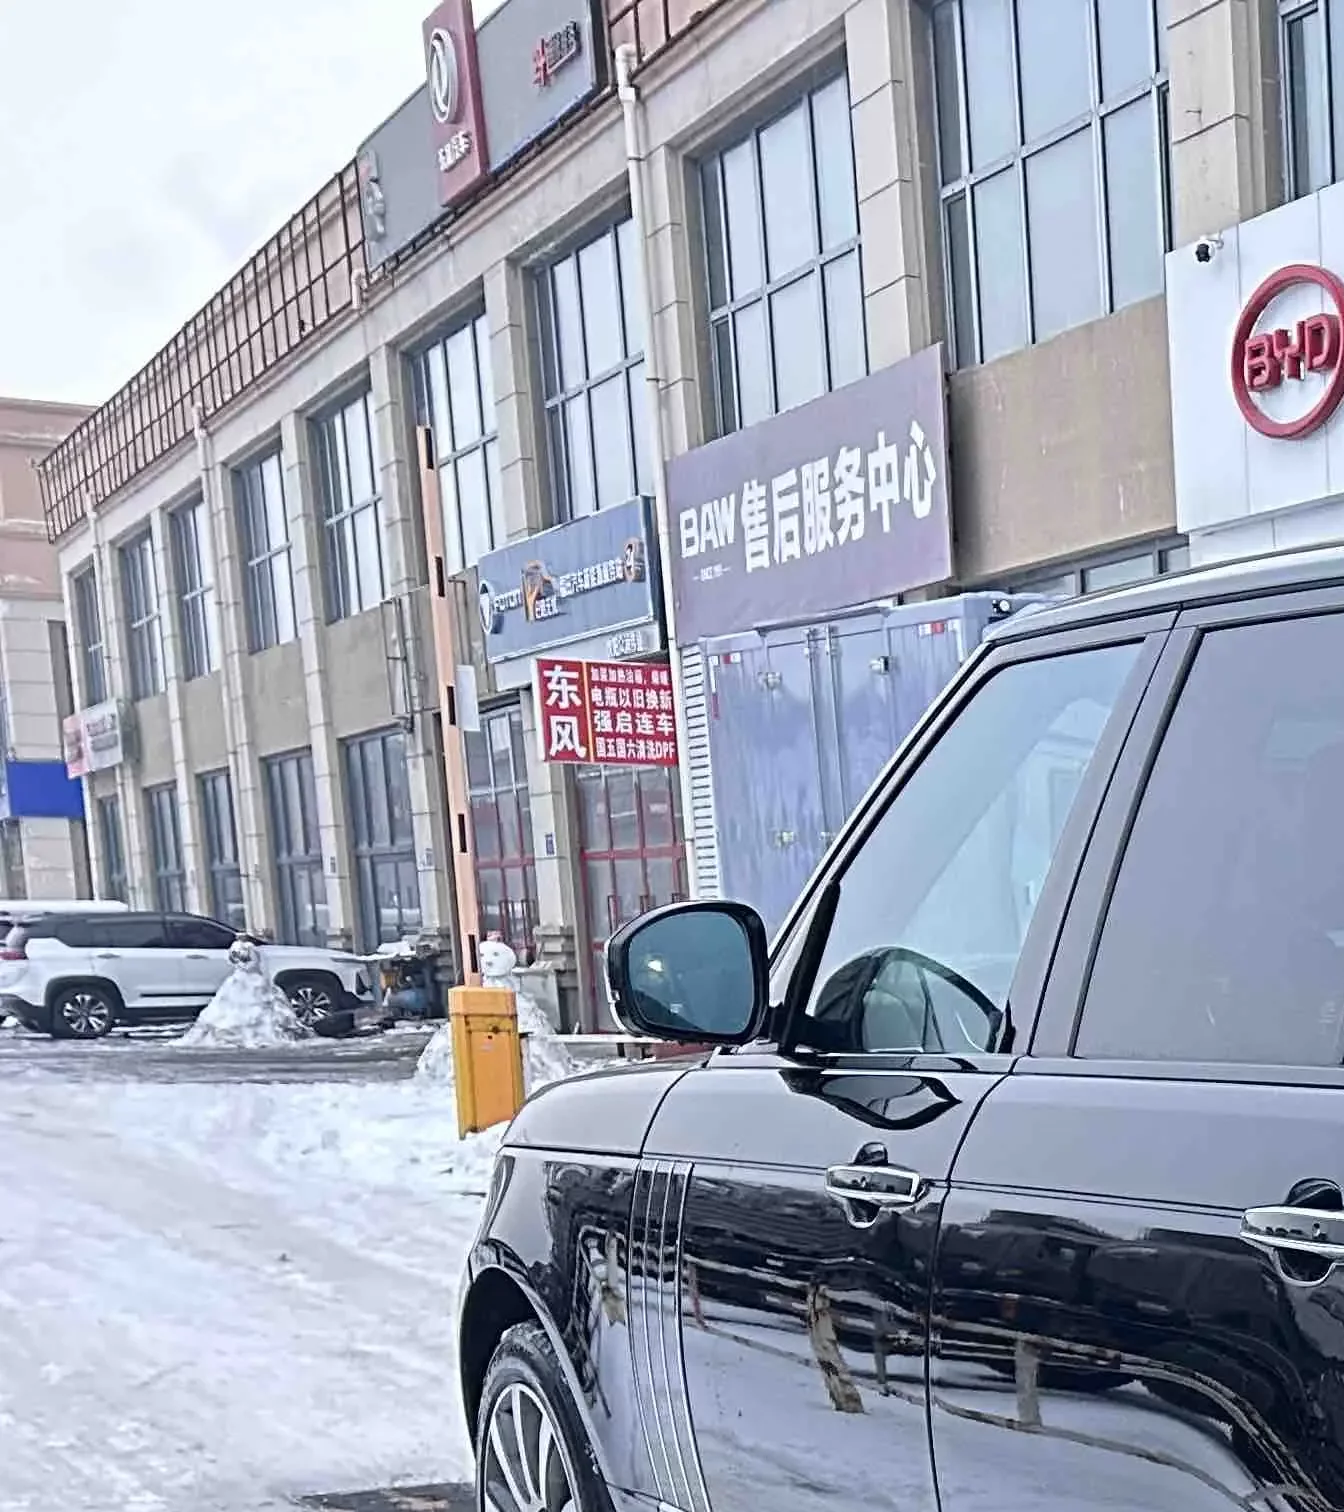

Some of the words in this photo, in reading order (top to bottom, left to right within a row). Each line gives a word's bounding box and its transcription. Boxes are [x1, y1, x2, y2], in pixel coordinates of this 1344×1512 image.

[1245, 313, 1339, 392] BYD
[679, 493, 735, 558] BAW
[740, 420, 936, 573] 售后服务中心
[543, 664, 587, 759] 东风
[591, 685, 673, 710] 电瓶以旧换新
[593, 710, 674, 736] 强启连车
